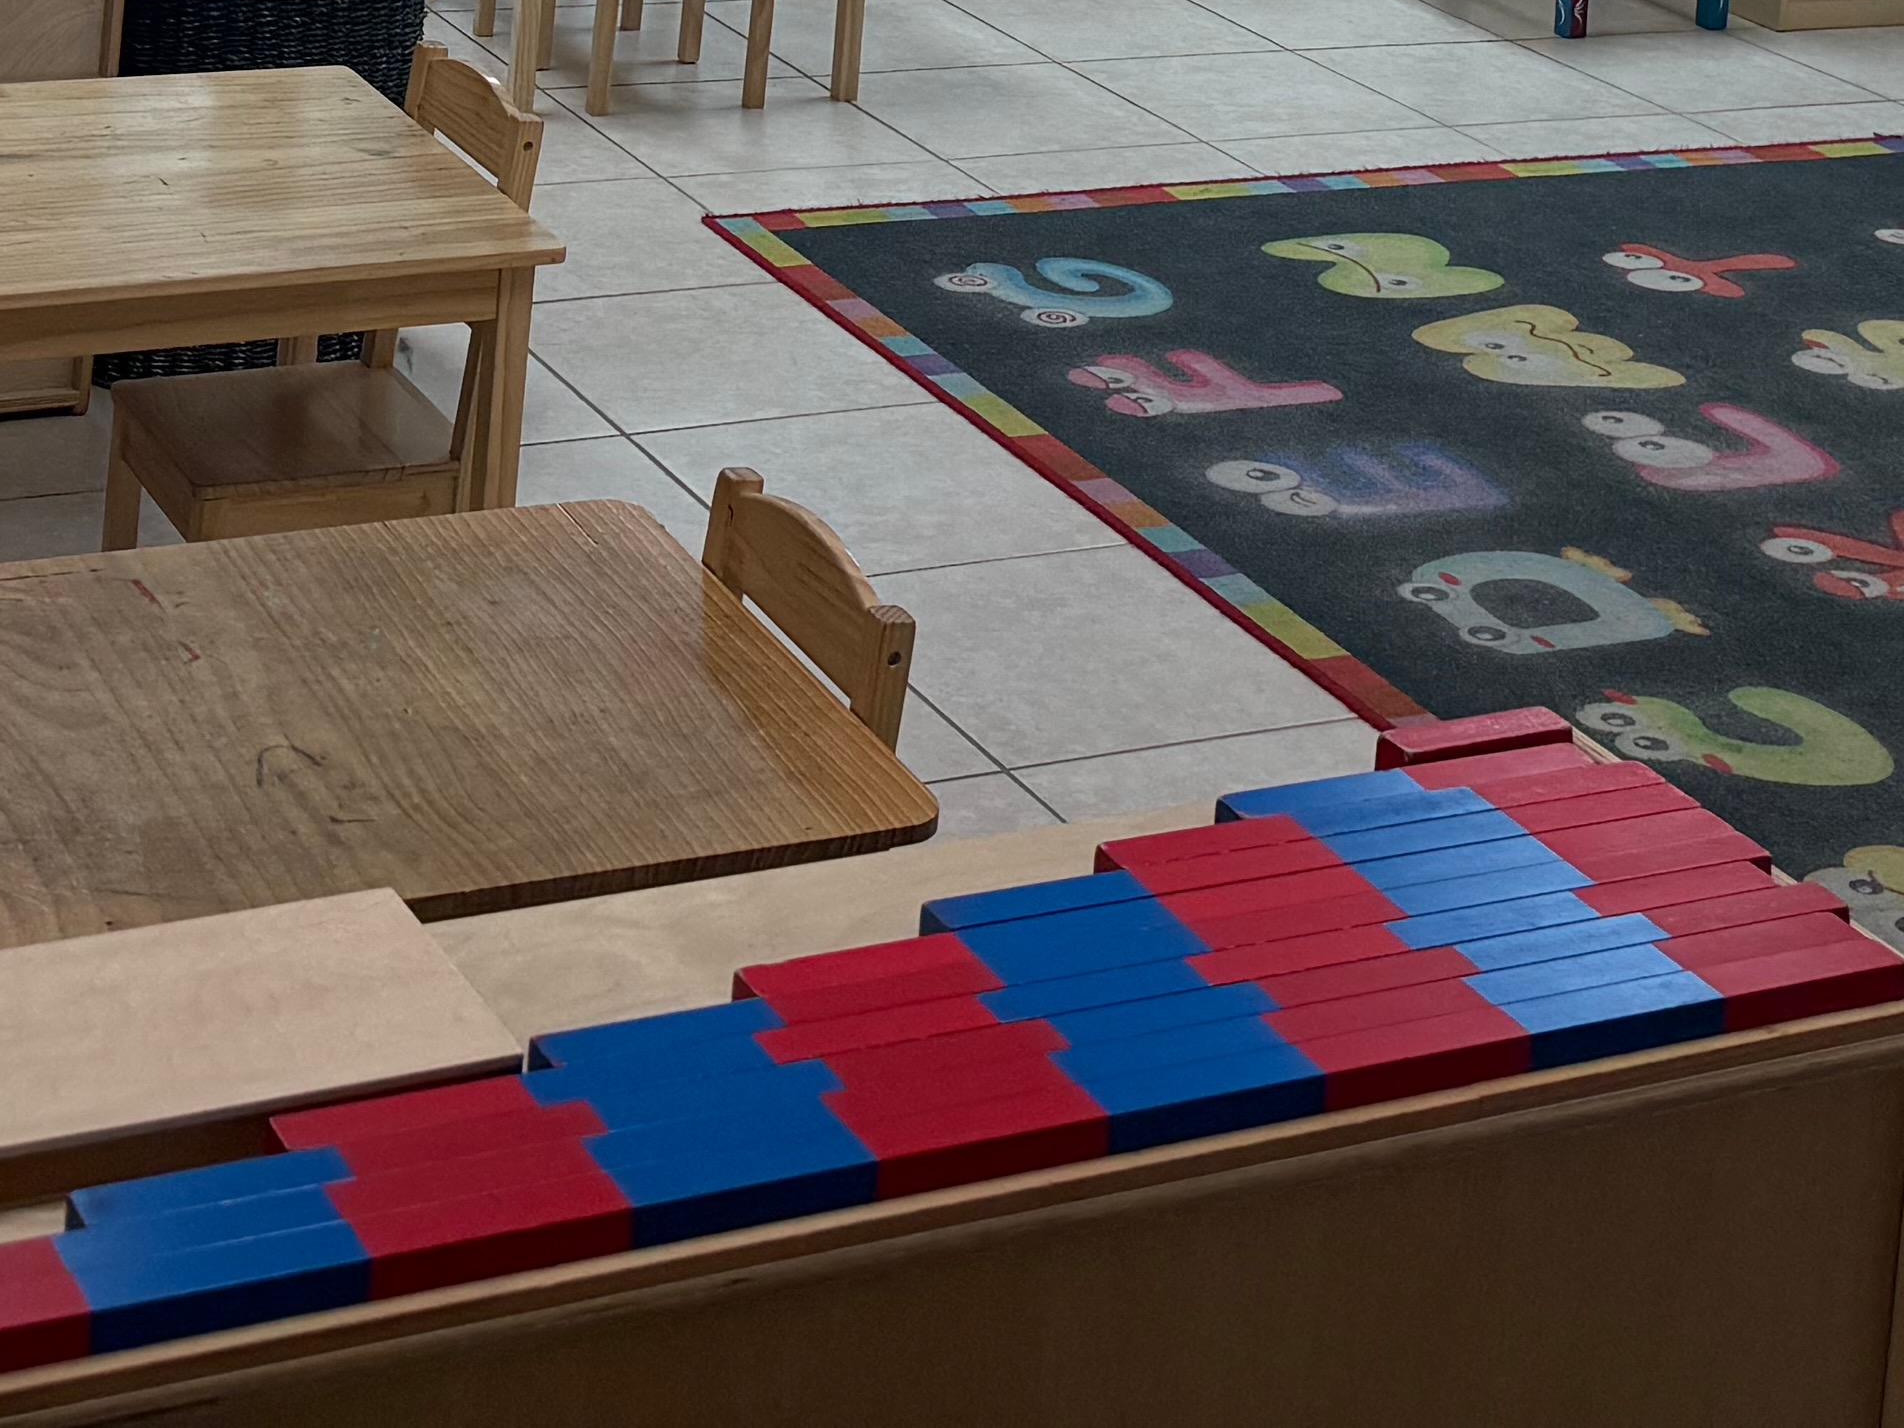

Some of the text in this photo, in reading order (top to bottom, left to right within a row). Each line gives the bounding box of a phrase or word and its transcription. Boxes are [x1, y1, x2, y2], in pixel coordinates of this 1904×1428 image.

[1068, 349, 1343, 417] F
[1412, 303, 1687, 389] M
[1399, 547, 1710, 654] D
[1574, 687, 1895, 789] C
